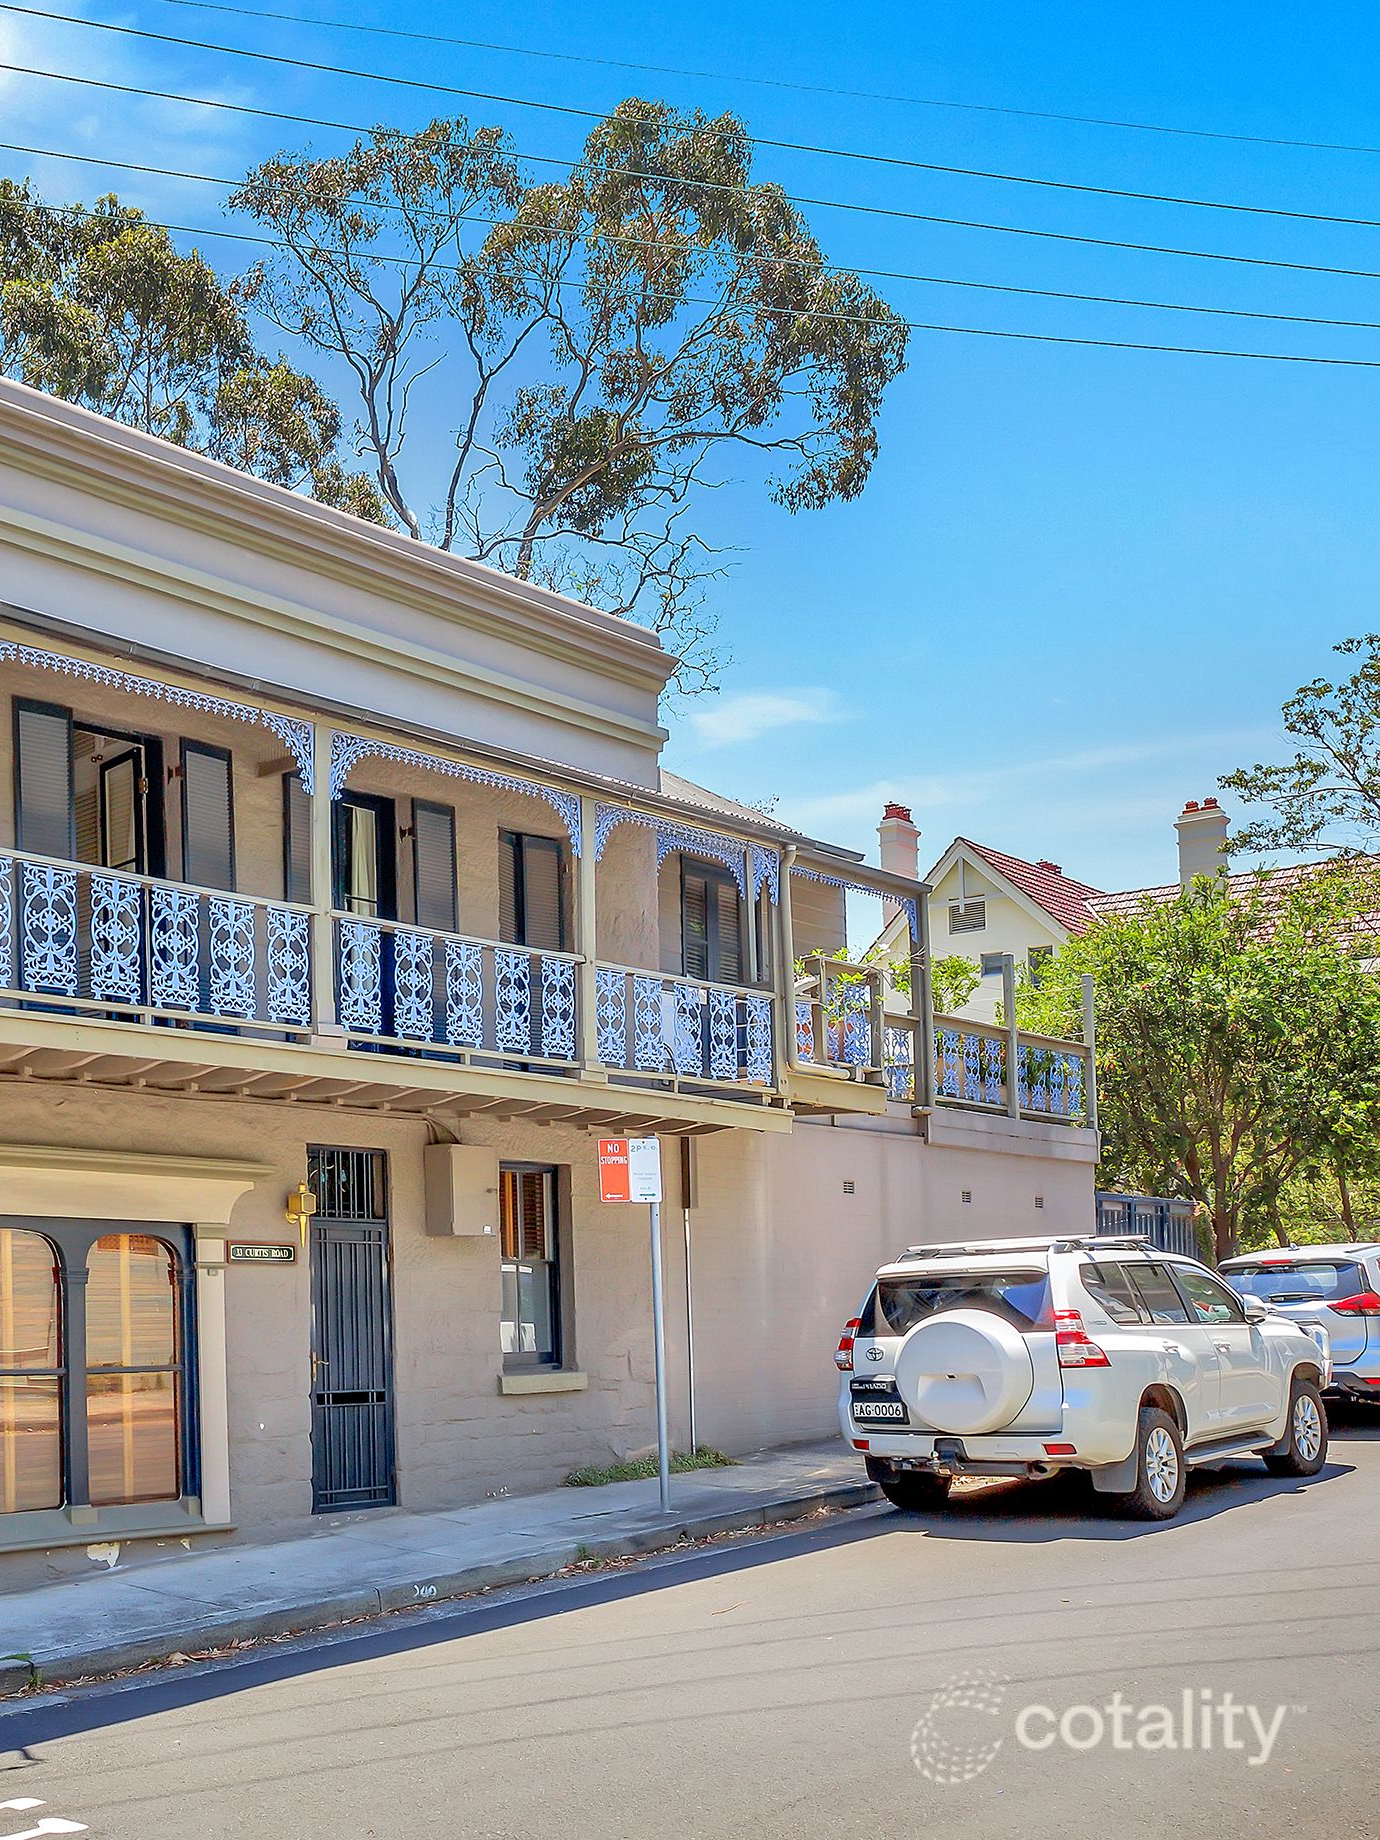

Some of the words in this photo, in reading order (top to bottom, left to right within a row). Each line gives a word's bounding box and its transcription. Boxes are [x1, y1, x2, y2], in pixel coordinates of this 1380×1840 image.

[607, 1143, 620, 1153] NO
[600, 1156, 627, 1164] STOPPING
[245, 1249, 268, 1257] CURTIS
[271, 1249, 288, 1257] ROAD
